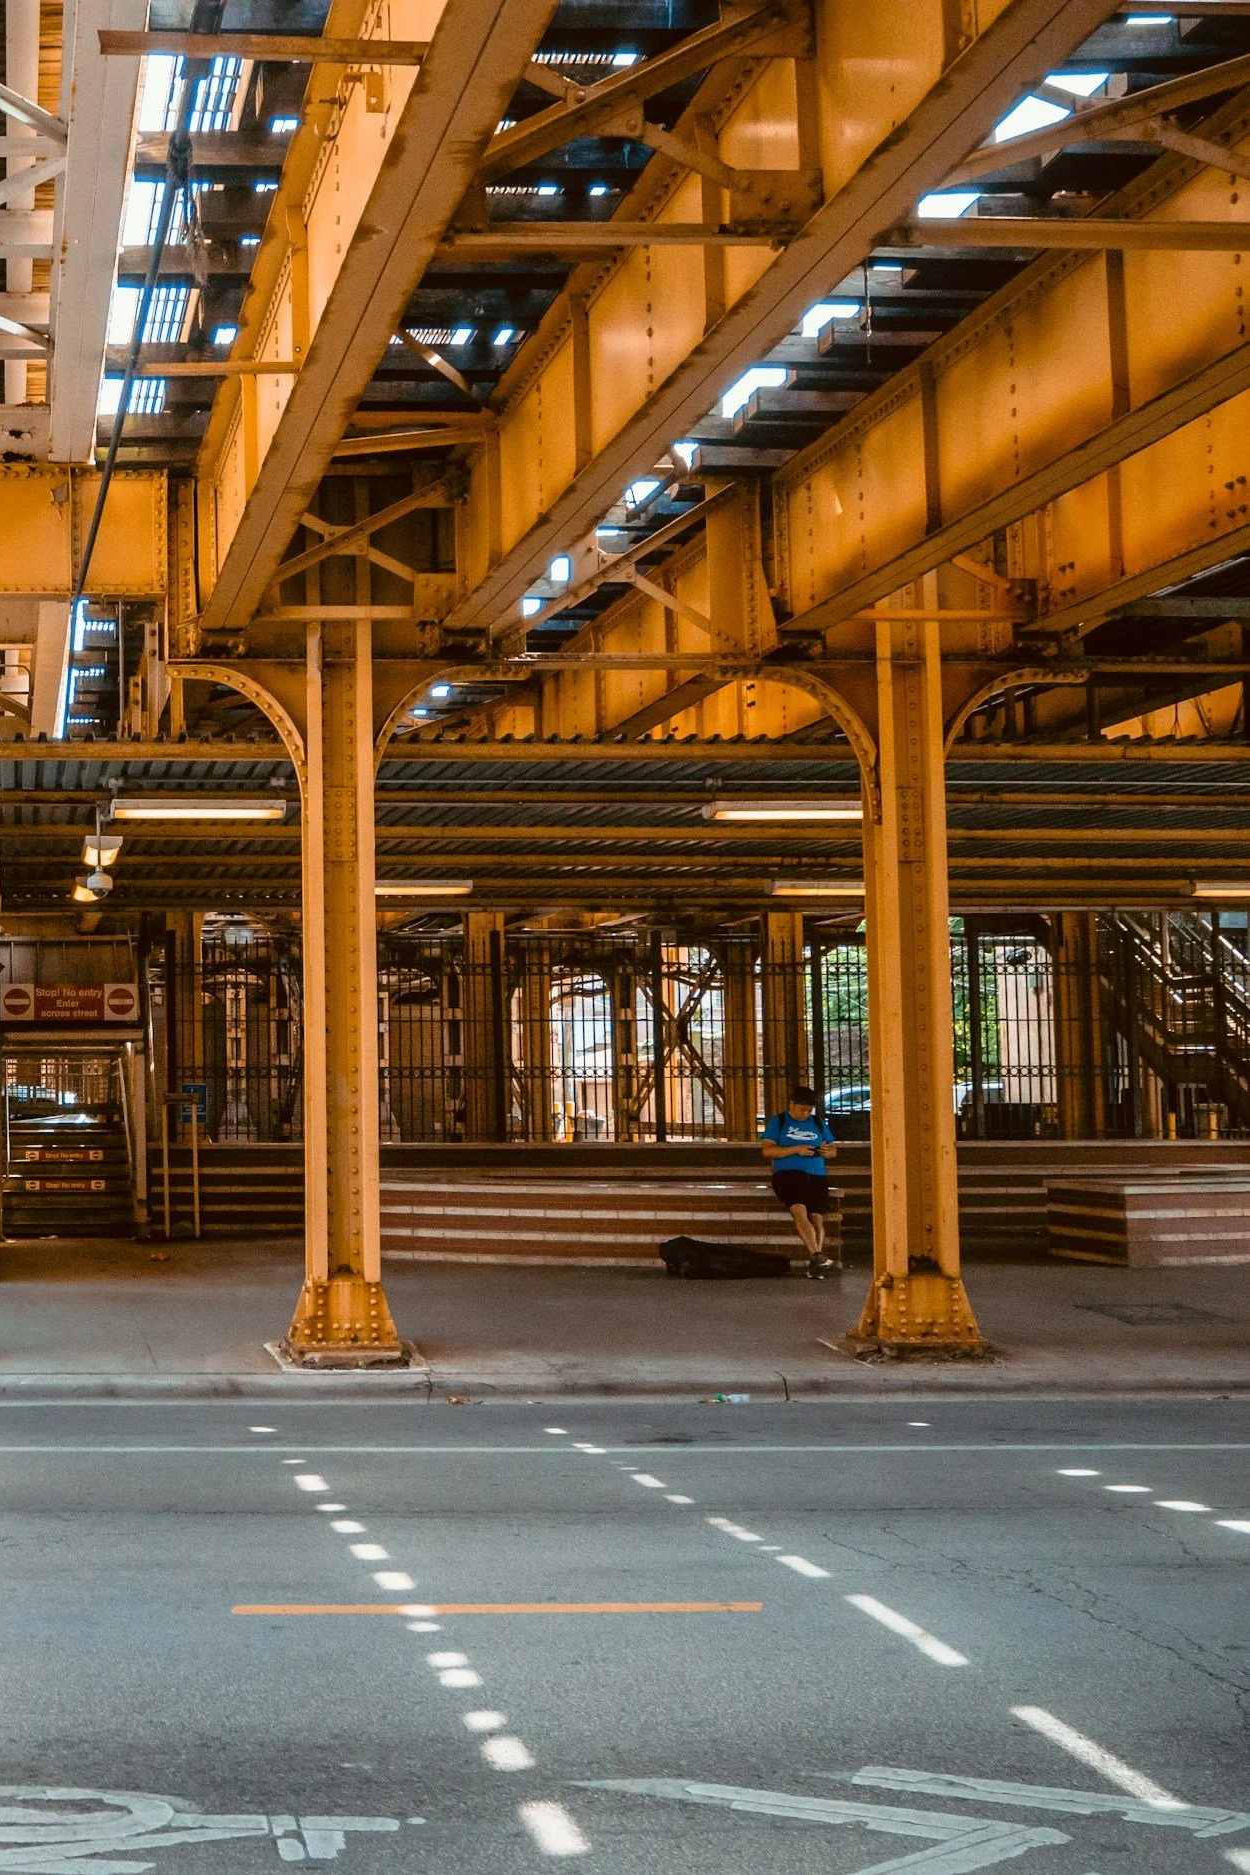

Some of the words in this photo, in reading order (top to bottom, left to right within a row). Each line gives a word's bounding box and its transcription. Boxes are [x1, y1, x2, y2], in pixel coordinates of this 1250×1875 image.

[35, 988, 60, 998] Stop!
[63, 988, 77, 997] No
[78, 989, 102, 998] entry
[56, 999, 80, 1008] Enter
[41, 1010, 71, 1018] across
[72, 1009, 98, 1017] street
[71, 1182, 86, 1190] entry
